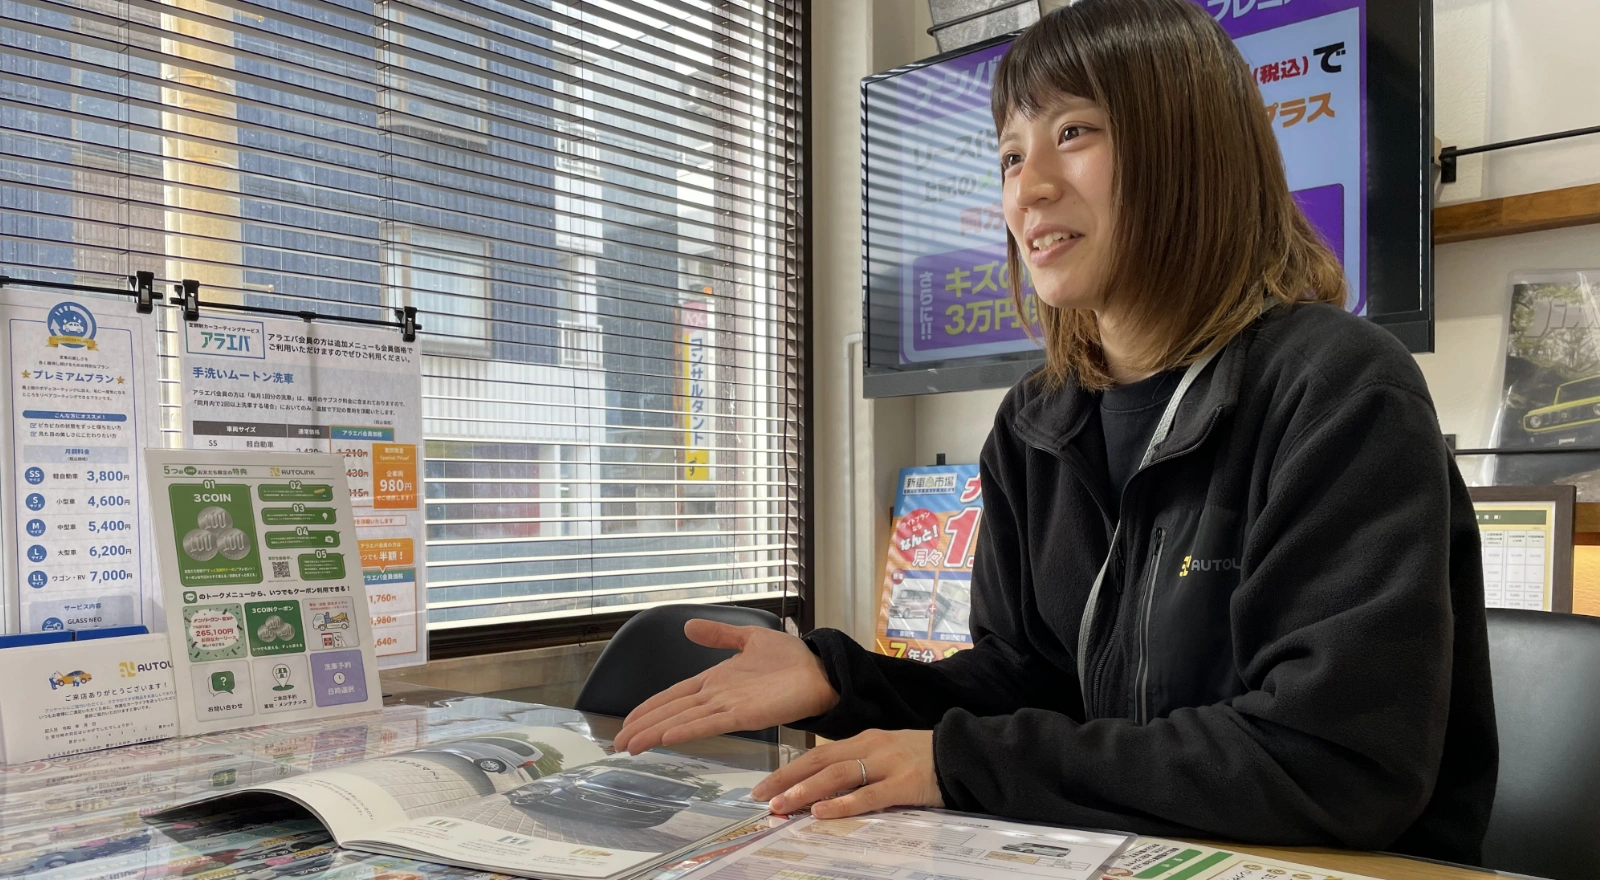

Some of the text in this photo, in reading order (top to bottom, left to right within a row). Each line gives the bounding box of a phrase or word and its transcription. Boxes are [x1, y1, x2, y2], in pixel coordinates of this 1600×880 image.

[269, 344, 411, 363] ご利用いただけますのでぜひご利用ください。
[33, 370, 114, 383] プレミアムプラン
[193, 366, 295, 385] 手洗いムートン洗車
[691, 338, 705, 446] コンサルタント
[246, 440, 274, 448] 軽自動車
[87, 470, 130, 484] 3,800円
[906, 476, 955, 488] 新車市場
[204, 480, 216, 490] 01
[290, 482, 302, 490] 02
[380, 479, 412, 492] 980円
[32, 496, 38, 504] S
[87, 495, 131, 509] 4,600円
[194, 494, 232, 502] 3COIN
[293, 504, 305, 512] 03
[88, 520, 131, 534] 5,400円
[296, 528, 309, 536] 04
[89, 545, 132, 559] 6,200円
[316, 550, 327, 558] 05
[912, 548, 943, 567] 月々
[52, 574, 86, 582] ワゴン・RV
[90, 569, 133, 583] 7,000円
[199, 585, 350, 601] のトークメニューから、いつでもクーポン利用できる！
[369, 594, 396, 604] 1,760円
[64, 602, 102, 611] サービス内容
[252, 606, 294, 614] 3COINクーポン
[196, 628, 234, 637] 265,100円
[324, 661, 352, 670] 洗車予約
[65, 683, 168, 702] ご来店ありがとうございます！
[328, 686, 355, 696] 日時選択
[273, 694, 298, 702] ご来店予約
[208, 702, 243, 712] お問い合わせ
[264, 699, 308, 710] 車検・メンテナンス
